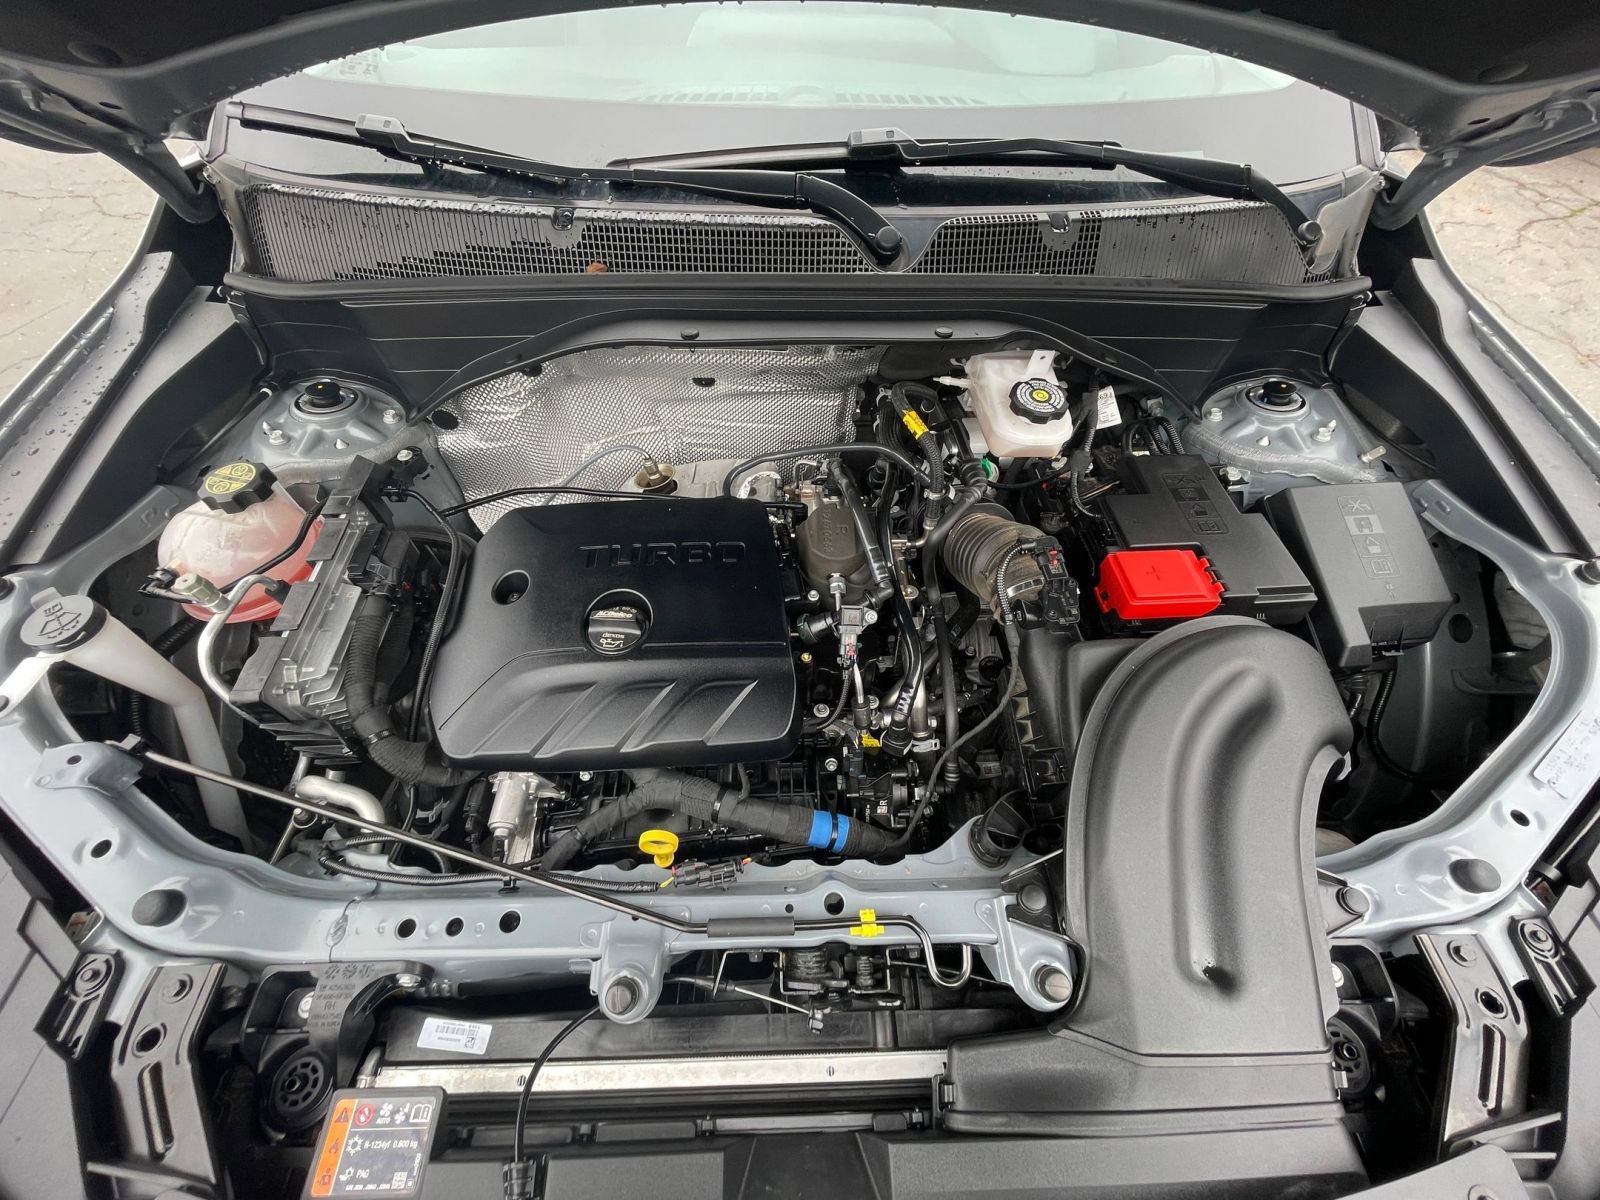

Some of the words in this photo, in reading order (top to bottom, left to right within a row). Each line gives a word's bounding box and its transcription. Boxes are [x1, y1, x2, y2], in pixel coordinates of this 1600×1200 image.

[579, 541, 746, 569] TURBO
[593, 610, 633, 619] ACDelco
[602, 631, 625, 639] dexos
